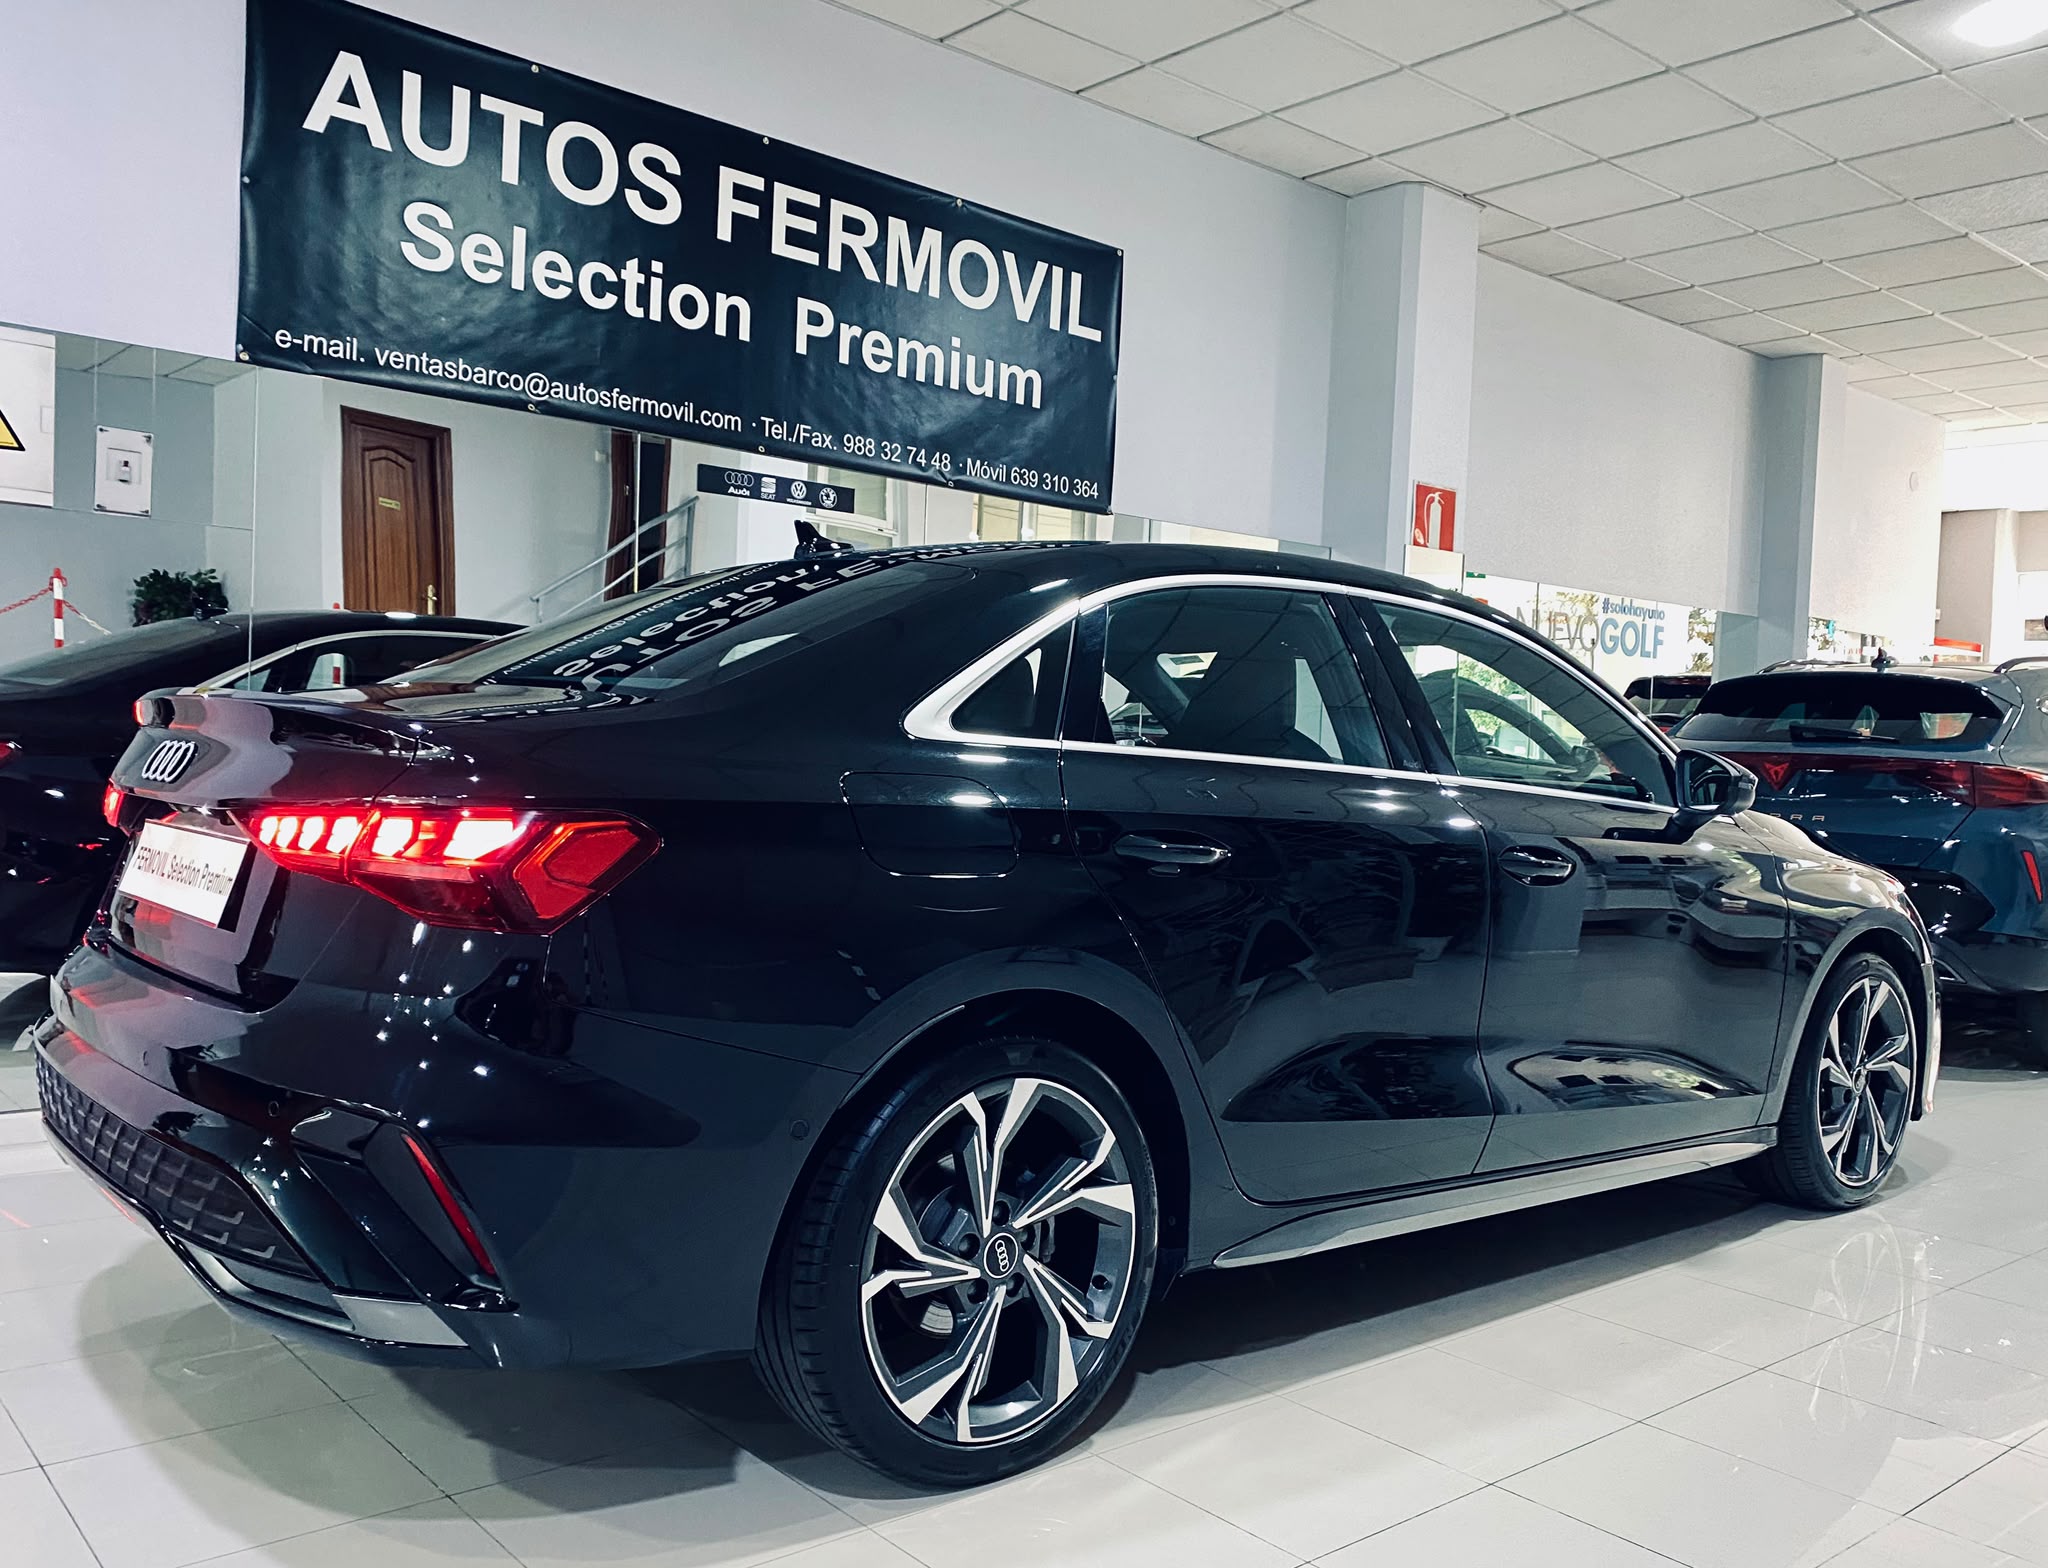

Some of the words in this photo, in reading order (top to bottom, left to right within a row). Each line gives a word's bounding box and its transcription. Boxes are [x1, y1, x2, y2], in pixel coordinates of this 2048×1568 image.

[302, 50, 682, 225] AUTOS
[716, 164, 1103, 343] FERMOVIL
[399, 200, 752, 342] Selection
[795, 296, 1043, 409] Premium
[275, 328, 365, 363] e-mail.
[374, 346, 742, 433] ventasbarco@autosfermovil.com
[760, 416, 837, 451] Tel./Fax.
[843, 433, 876, 458] 988
[880, 441, 901, 463] 32
[906, 446, 927, 468] 74
[931, 452, 951, 472] 48
[966, 457, 1007, 483] Móvil
[1010, 466, 1039, 488] 639
[1042, 472, 1069, 494] 310
[1072, 478, 1099, 499] 364
[728, 485, 750, 497] Audi
[760, 492, 776, 501] SEAT
[1602, 597, 1665, 622] #solohayuno
[133, 846, 169, 877] FERMOVIL
[167, 854, 201, 889] Selection
[202, 862, 233, 897] Premium
